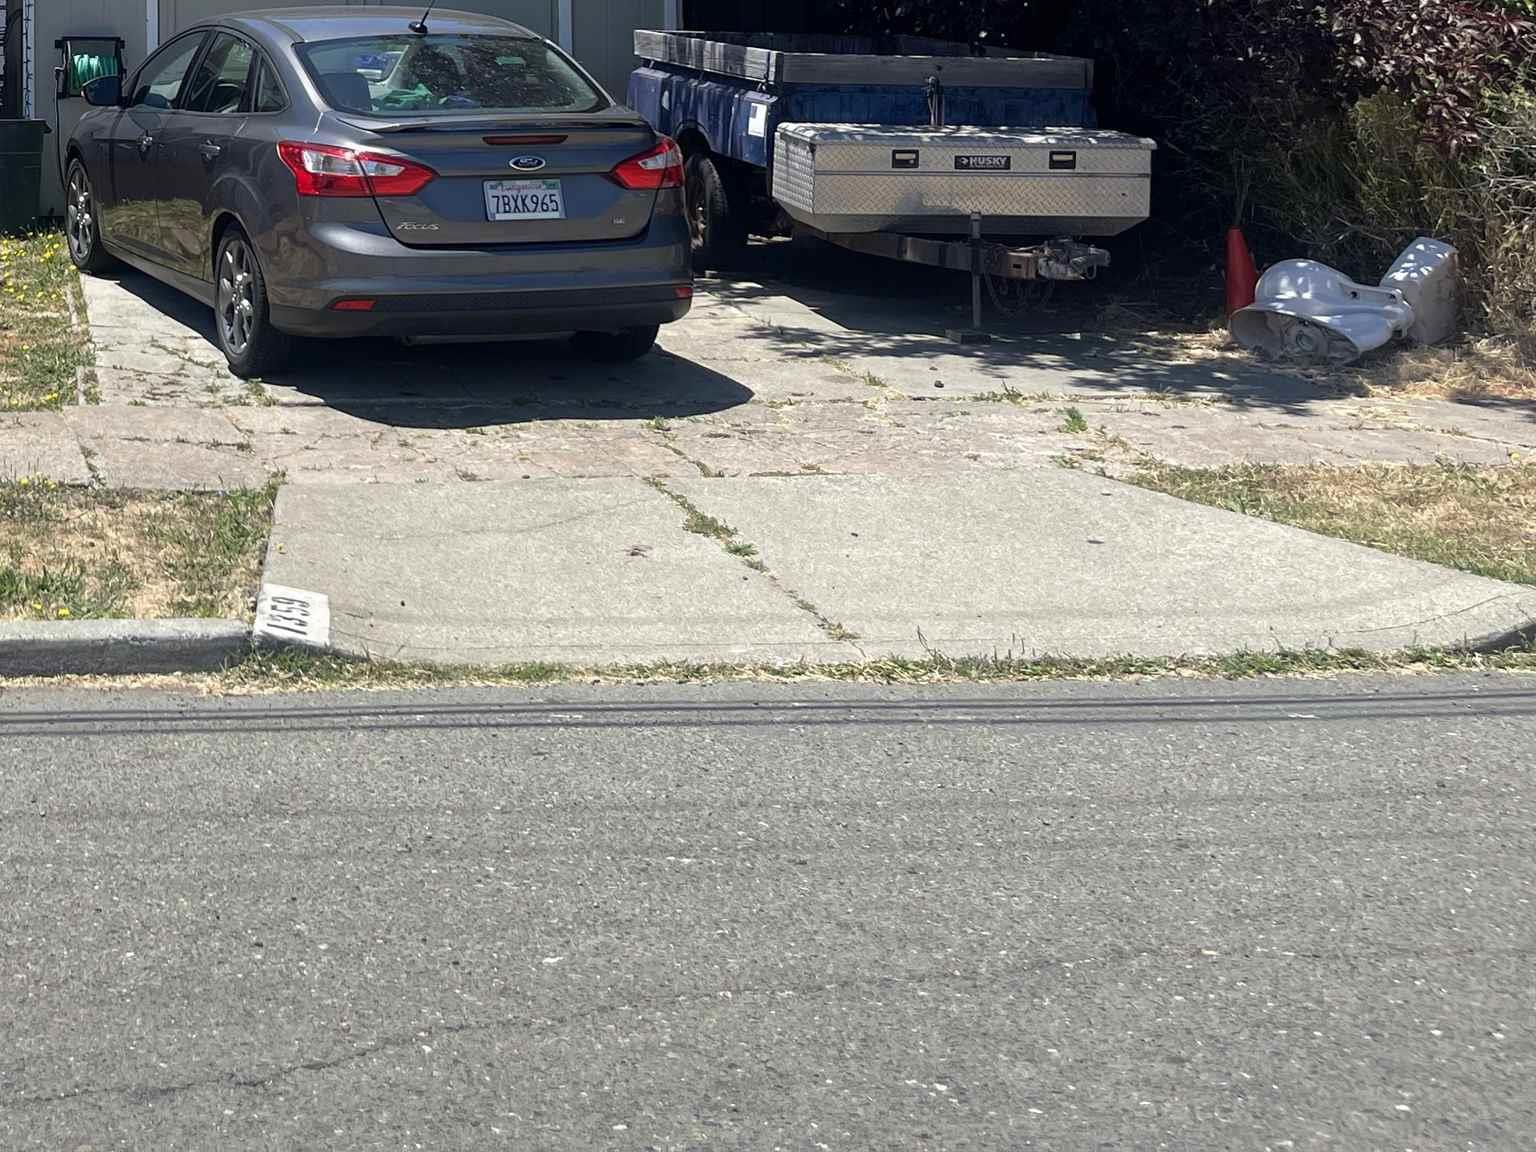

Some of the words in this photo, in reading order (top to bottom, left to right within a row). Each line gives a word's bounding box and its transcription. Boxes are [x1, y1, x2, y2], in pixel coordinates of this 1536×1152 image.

[969, 156, 1008, 166] HUSKY
[491, 193, 559, 214] 7BXK965
[265, 595, 312, 636] 1359
